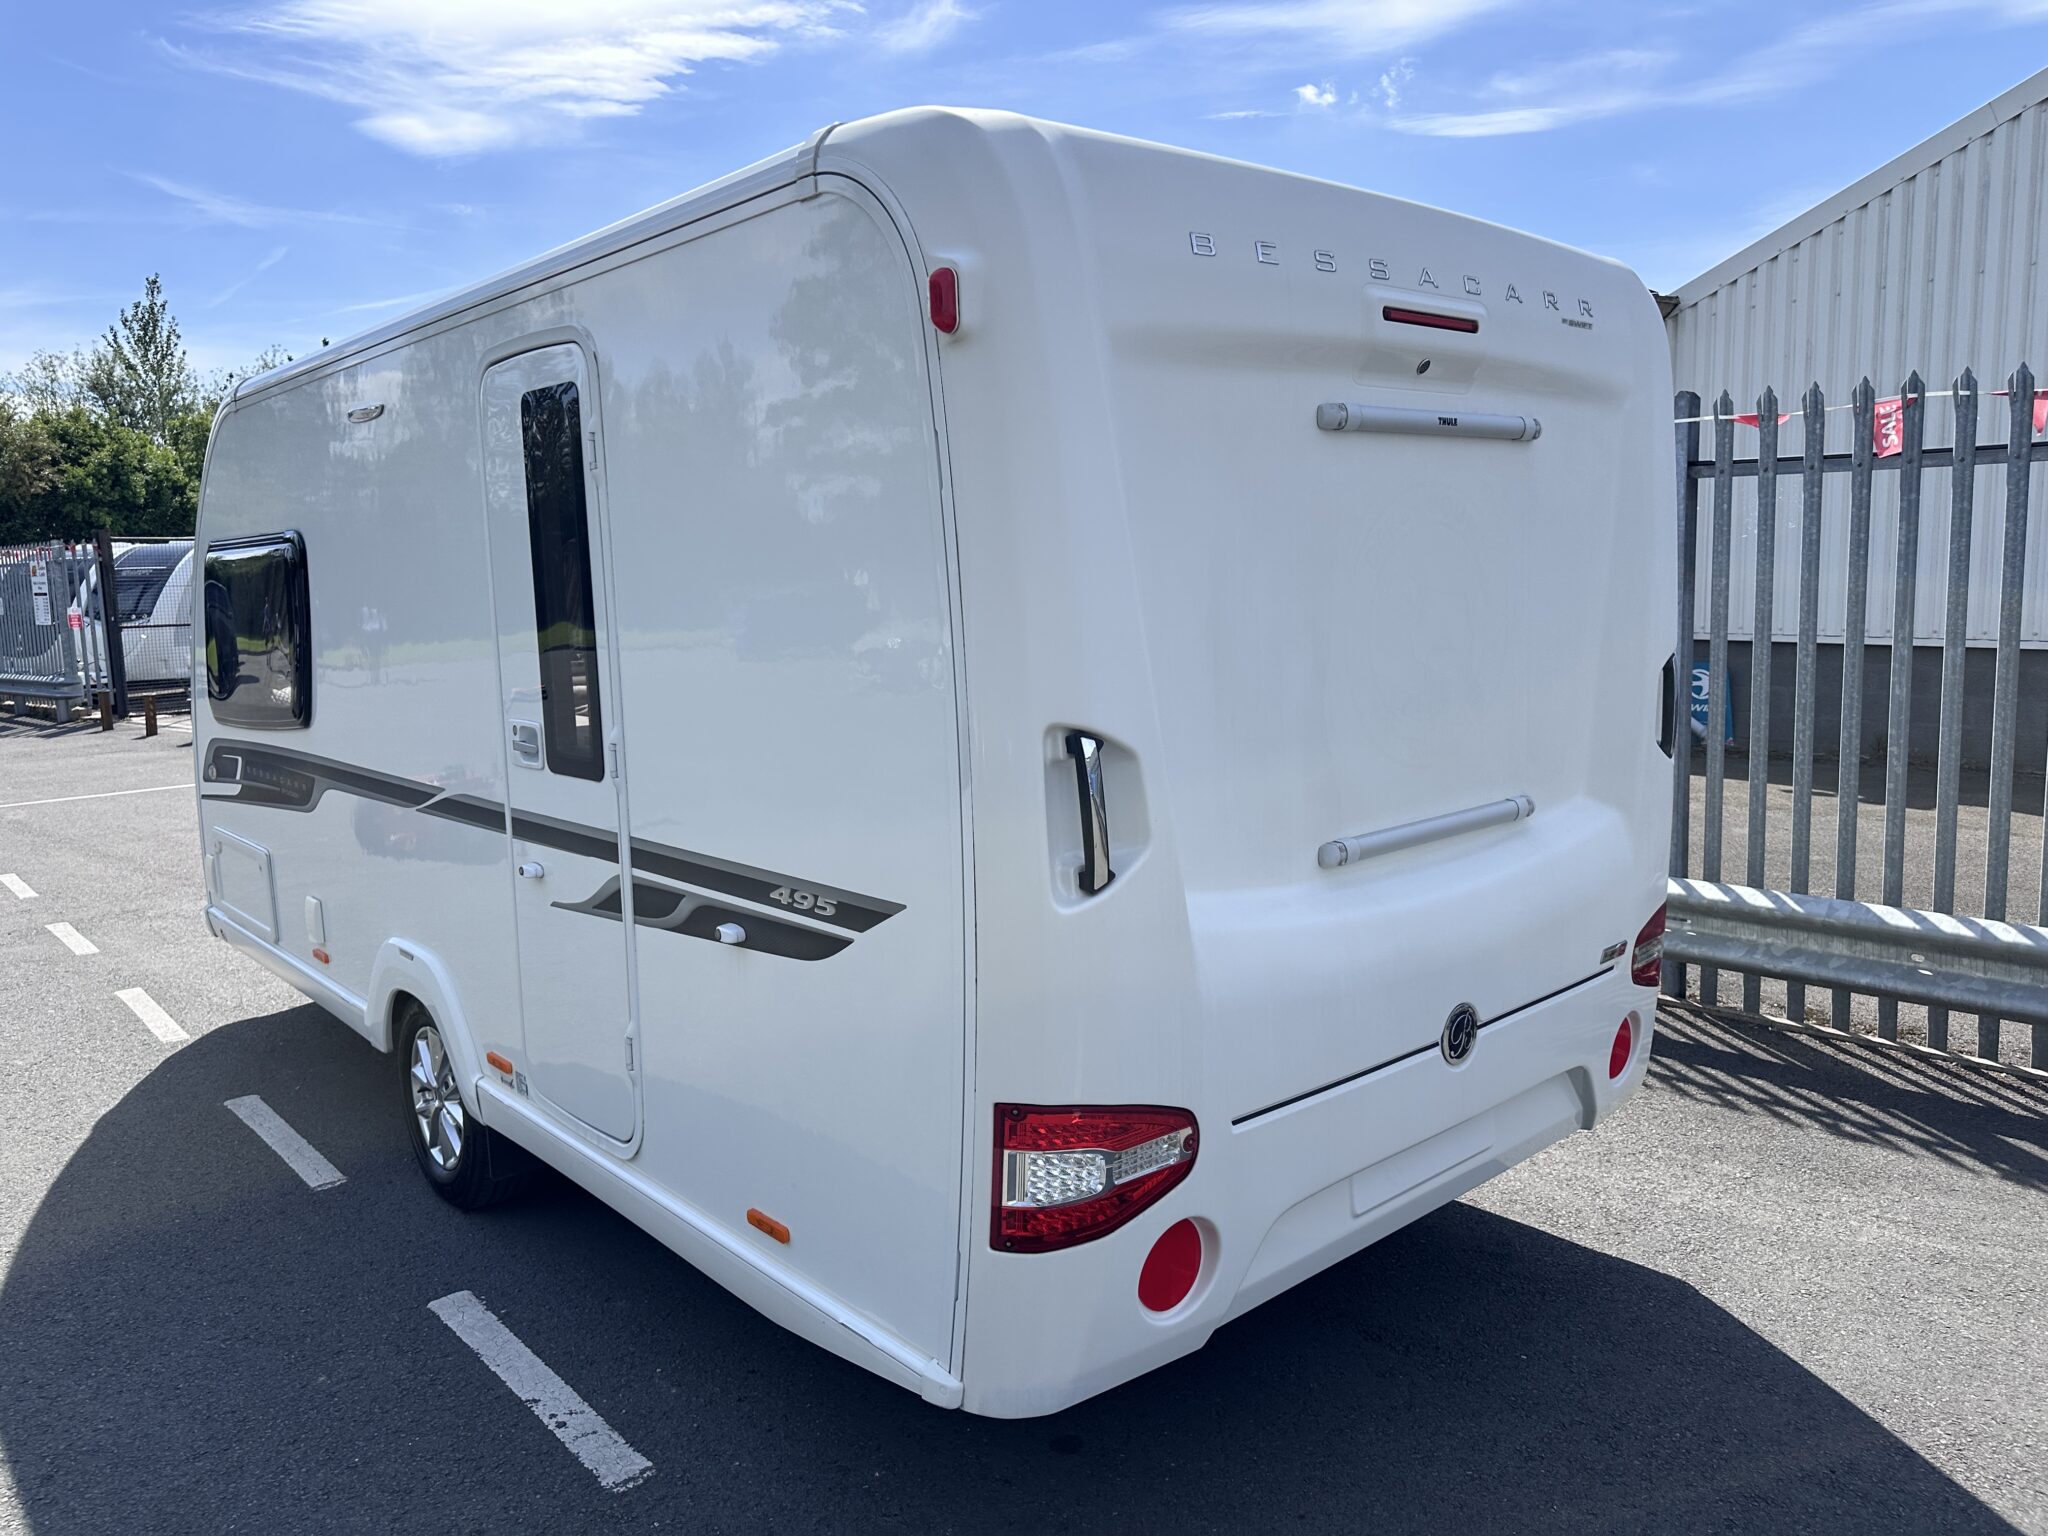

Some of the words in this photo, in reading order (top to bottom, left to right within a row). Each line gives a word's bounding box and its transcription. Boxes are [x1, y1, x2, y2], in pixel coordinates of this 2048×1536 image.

[1189, 231, 1594, 318] BESSACARR
[1437, 416, 1458, 427] THULE
[1879, 404, 1899, 448] SALE
[769, 886, 838, 916] 495
